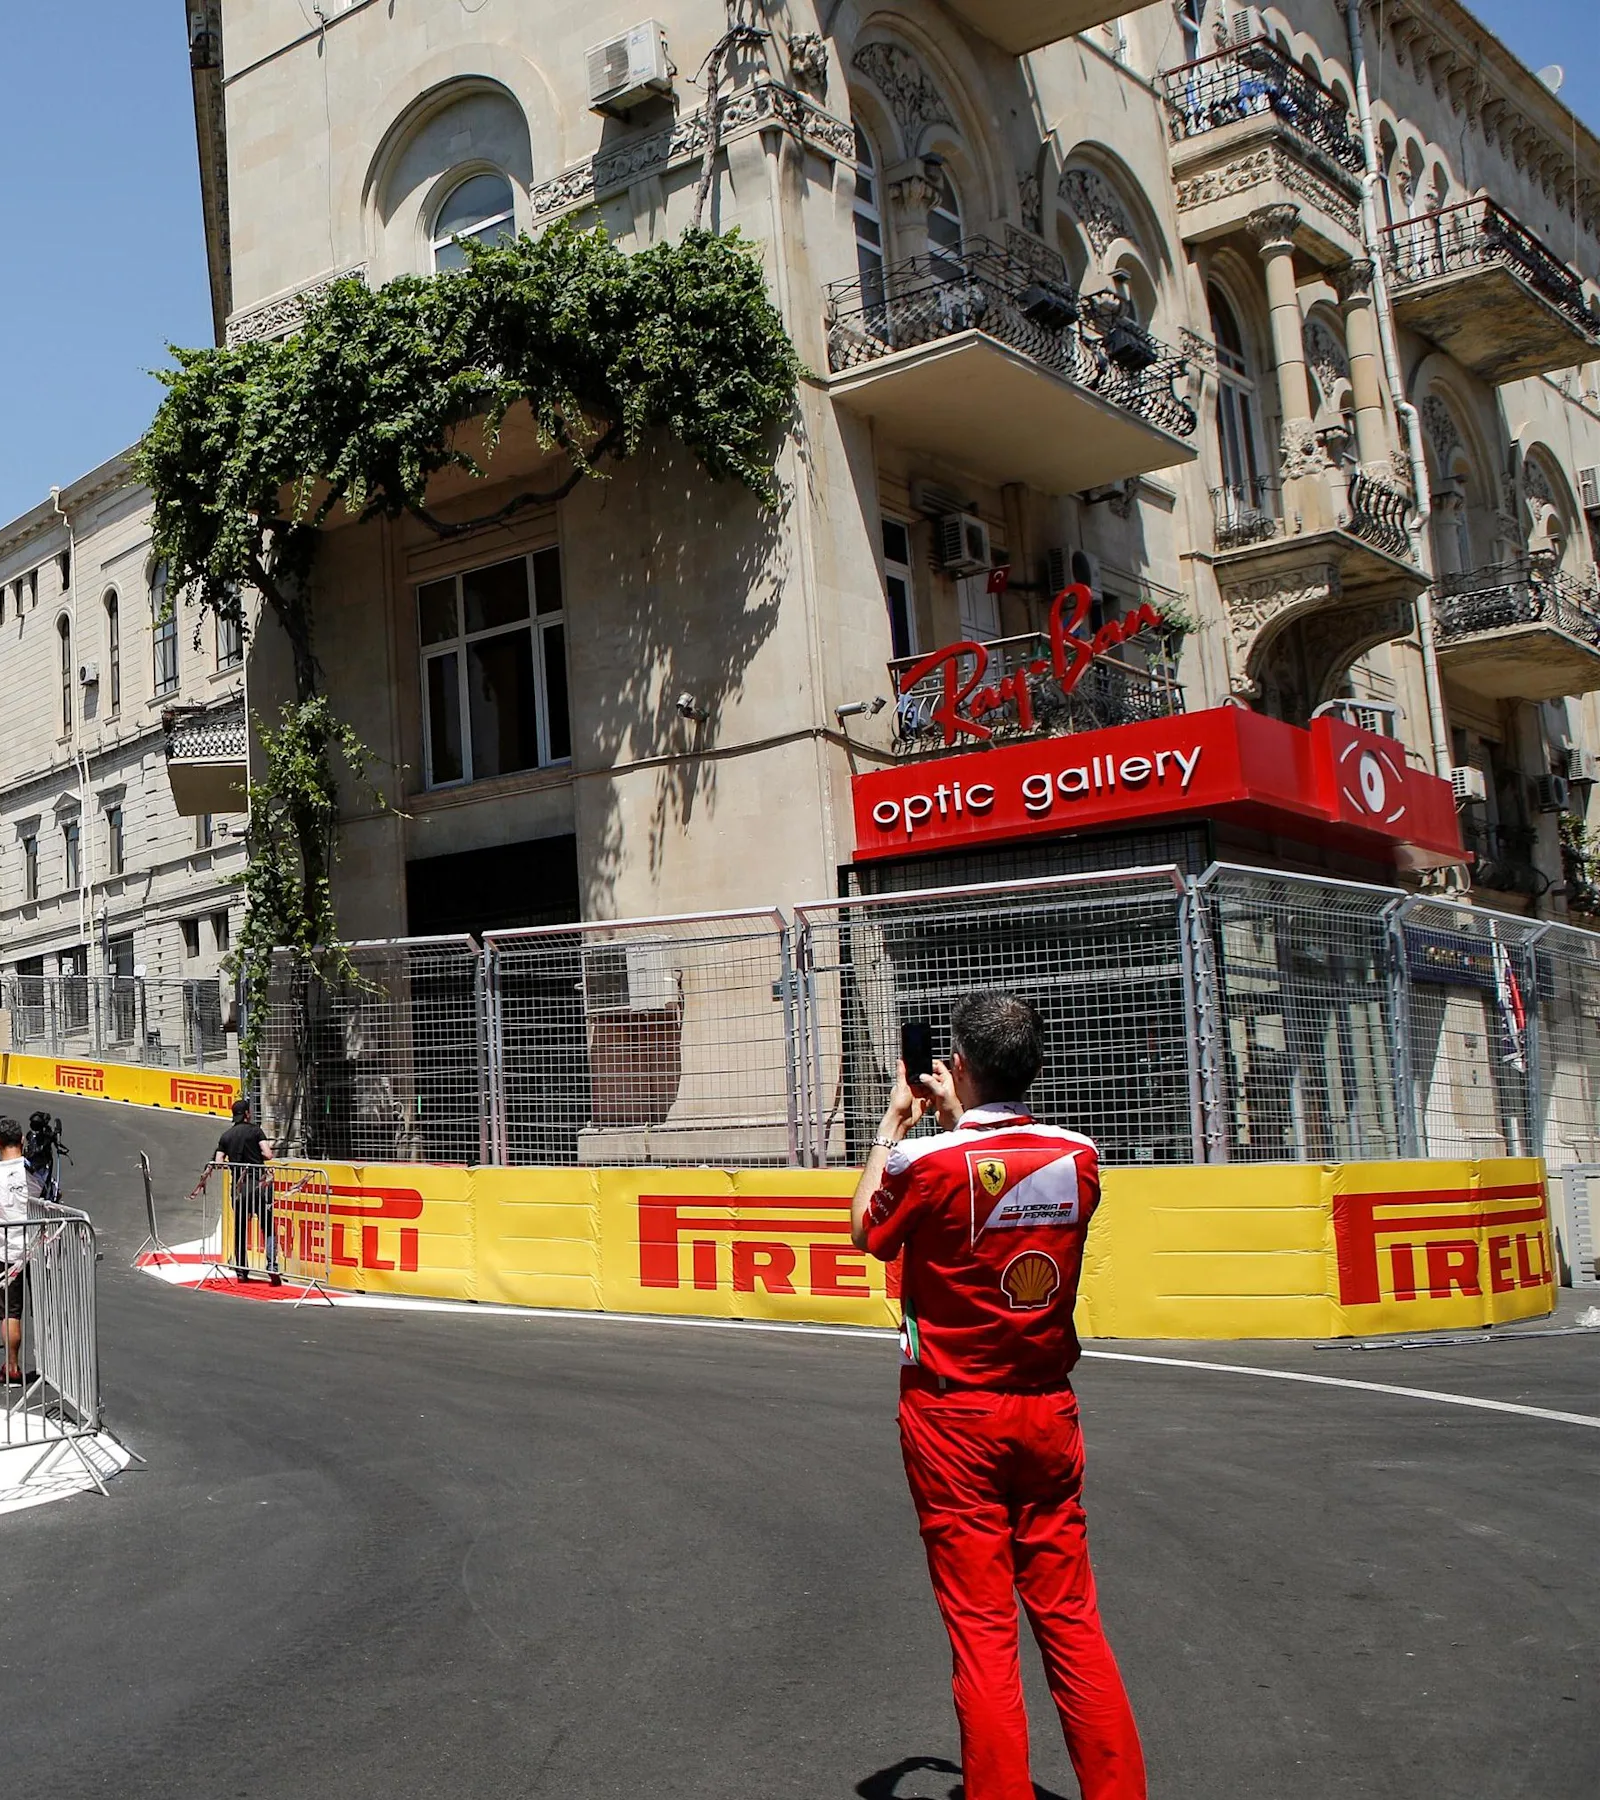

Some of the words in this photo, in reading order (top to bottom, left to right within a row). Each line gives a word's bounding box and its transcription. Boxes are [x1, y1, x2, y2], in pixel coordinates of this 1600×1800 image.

[899, 582, 1163, 746] Ray-Ban
[872, 780, 995, 833] optic
[1020, 746, 1202, 811] gallery
[55, 1064, 104, 1092] PIRELLI
[170, 1077, 233, 1110] PIRELLI
[1002, 1203, 1059, 1213] SCUDERIA
[1022, 1210, 1072, 1219] FERRARI
